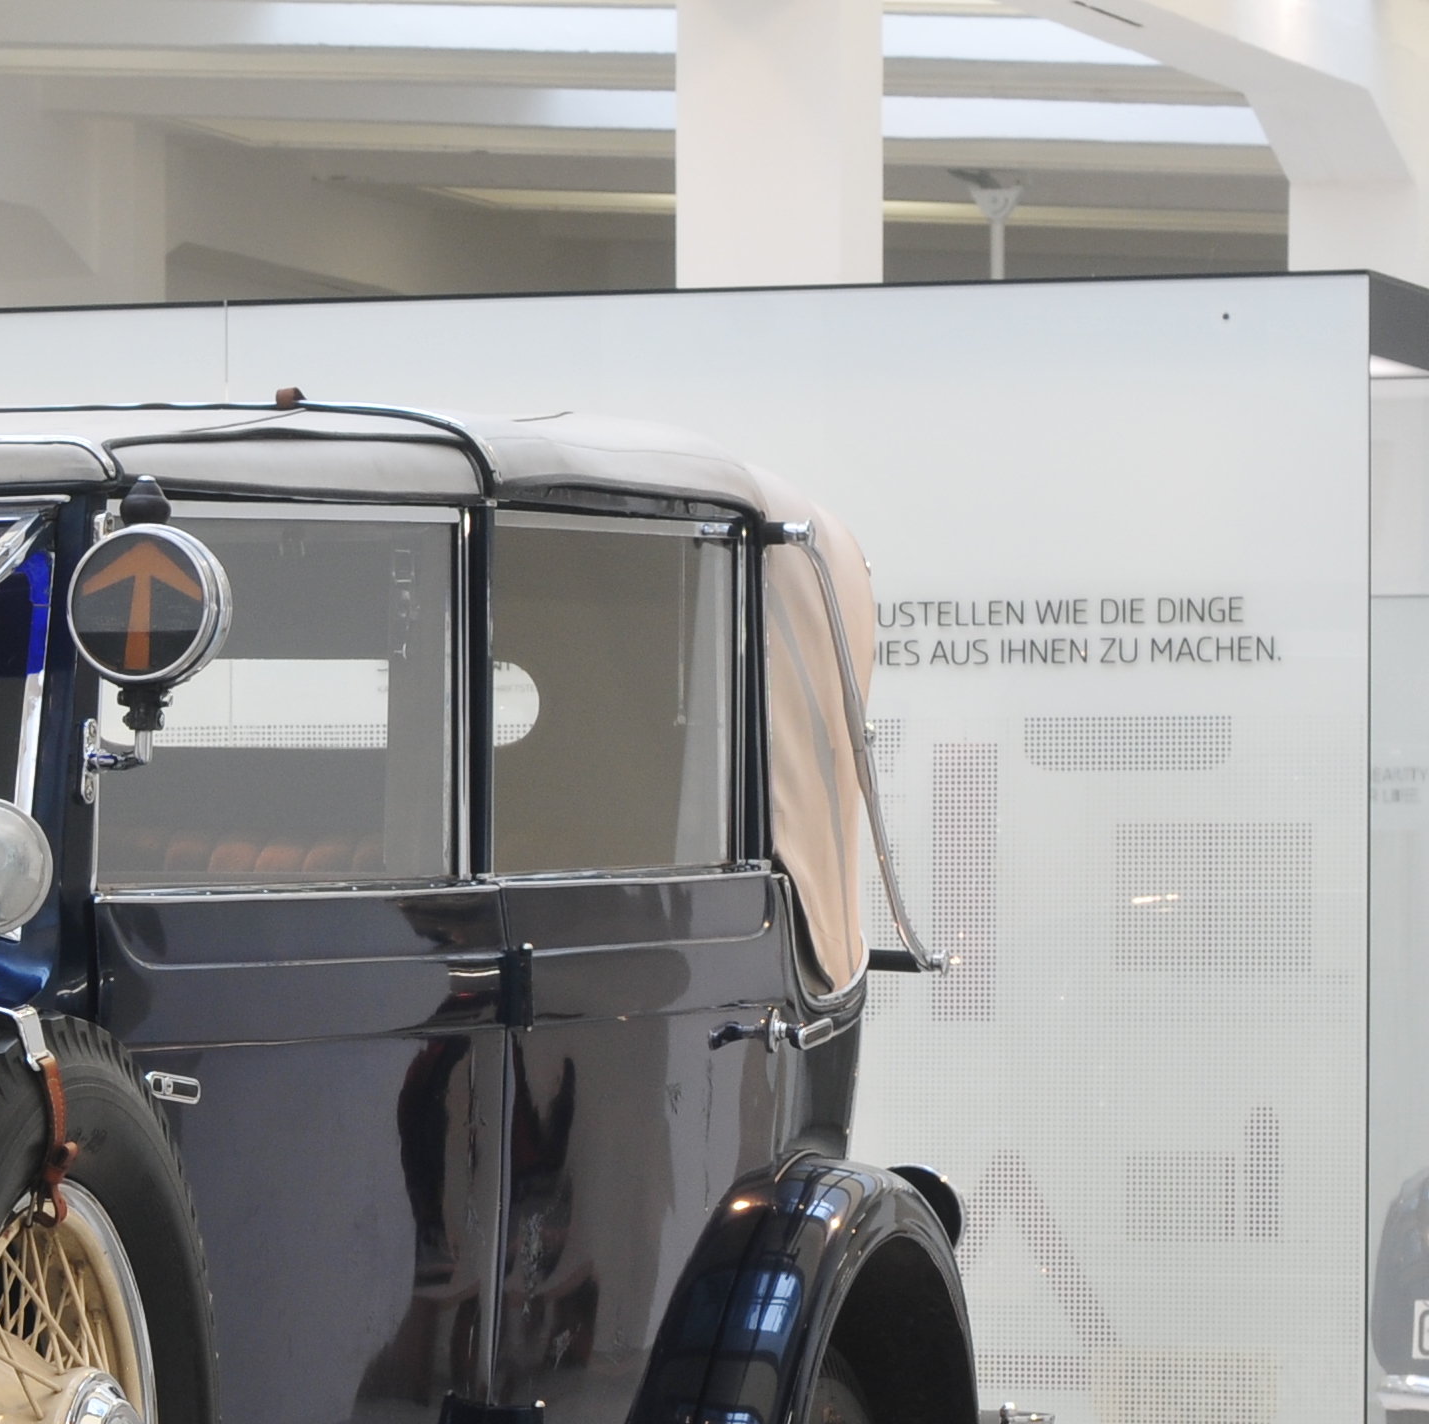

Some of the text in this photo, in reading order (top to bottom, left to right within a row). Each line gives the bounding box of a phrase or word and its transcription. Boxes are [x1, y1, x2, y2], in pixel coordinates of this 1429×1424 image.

[876, 596, 1244, 628] USTELLEN WIE DIE DINGE
[874, 635, 1282, 666] IES AUS IHNEN ZU MACHEN.
